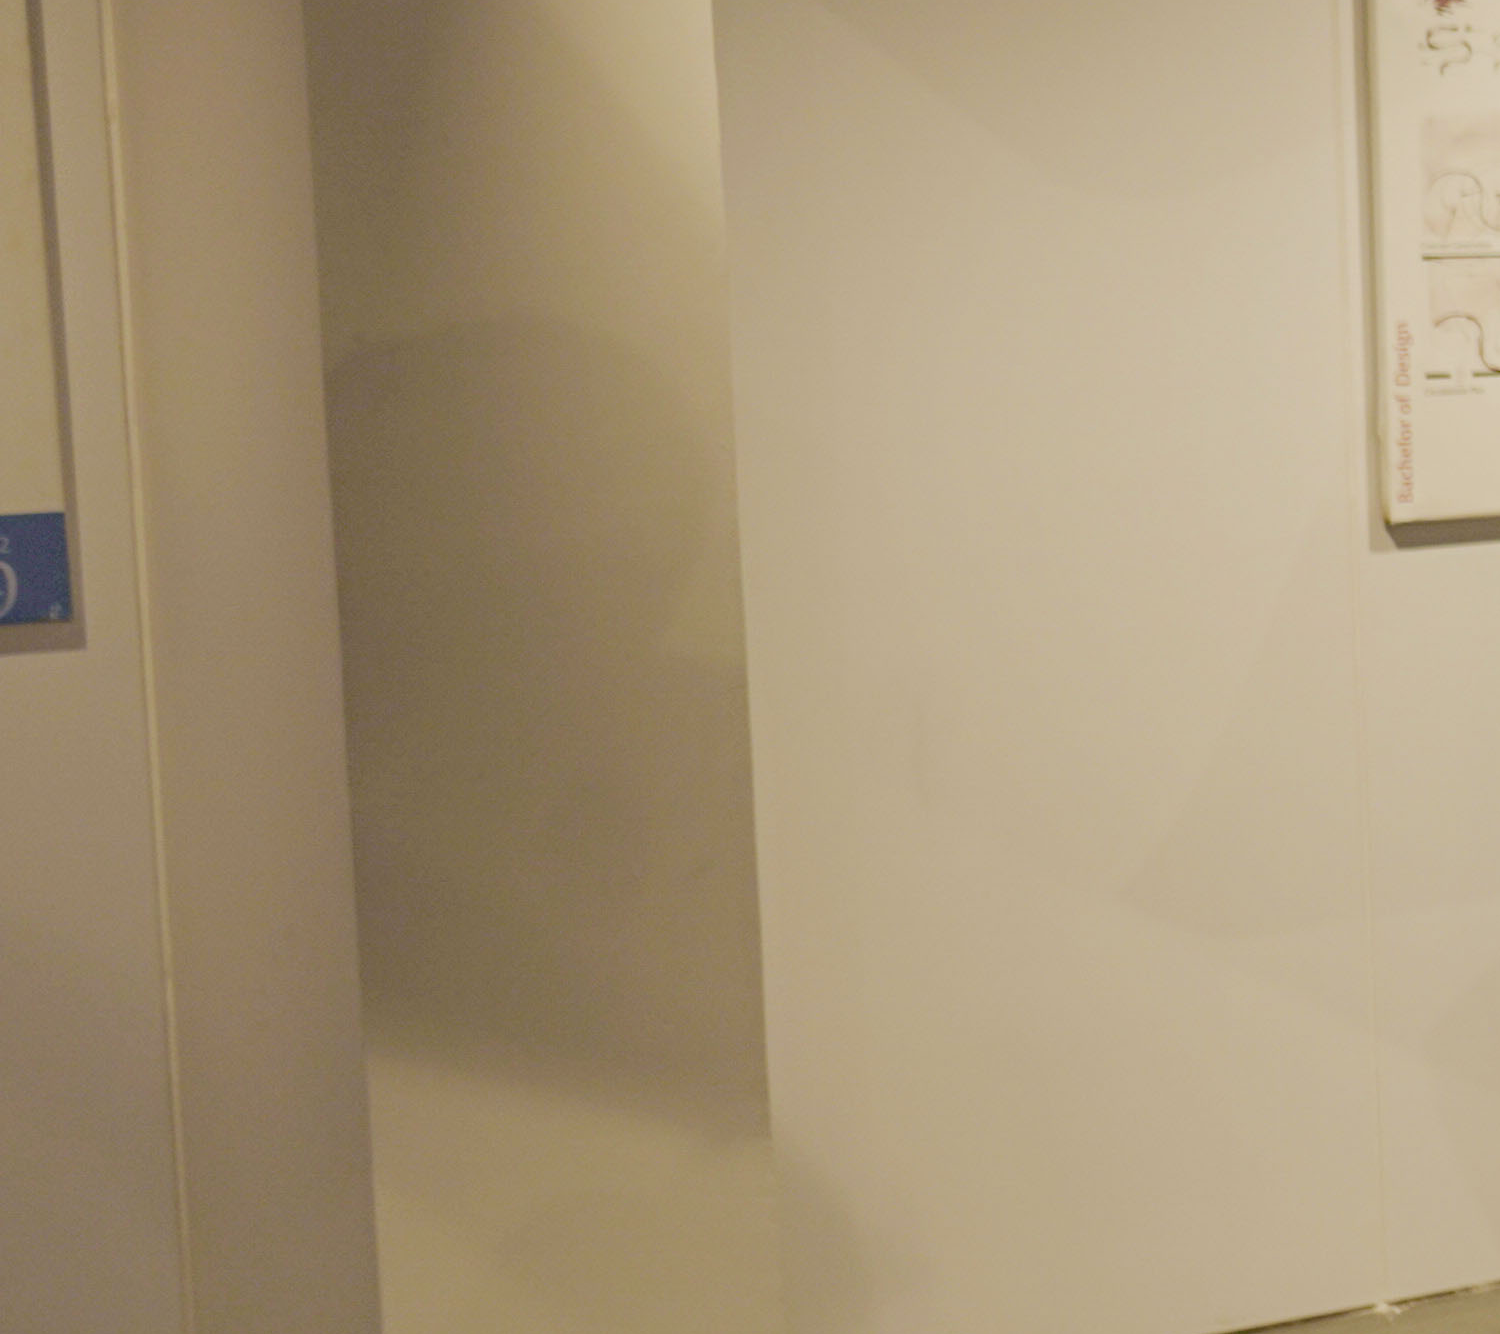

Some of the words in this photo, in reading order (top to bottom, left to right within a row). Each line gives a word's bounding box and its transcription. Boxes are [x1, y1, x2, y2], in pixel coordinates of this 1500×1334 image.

[1394, 321, 1414, 387] Design
[1395, 394, 1412, 415] of
[1396, 419, 1414, 504] Bachelor
